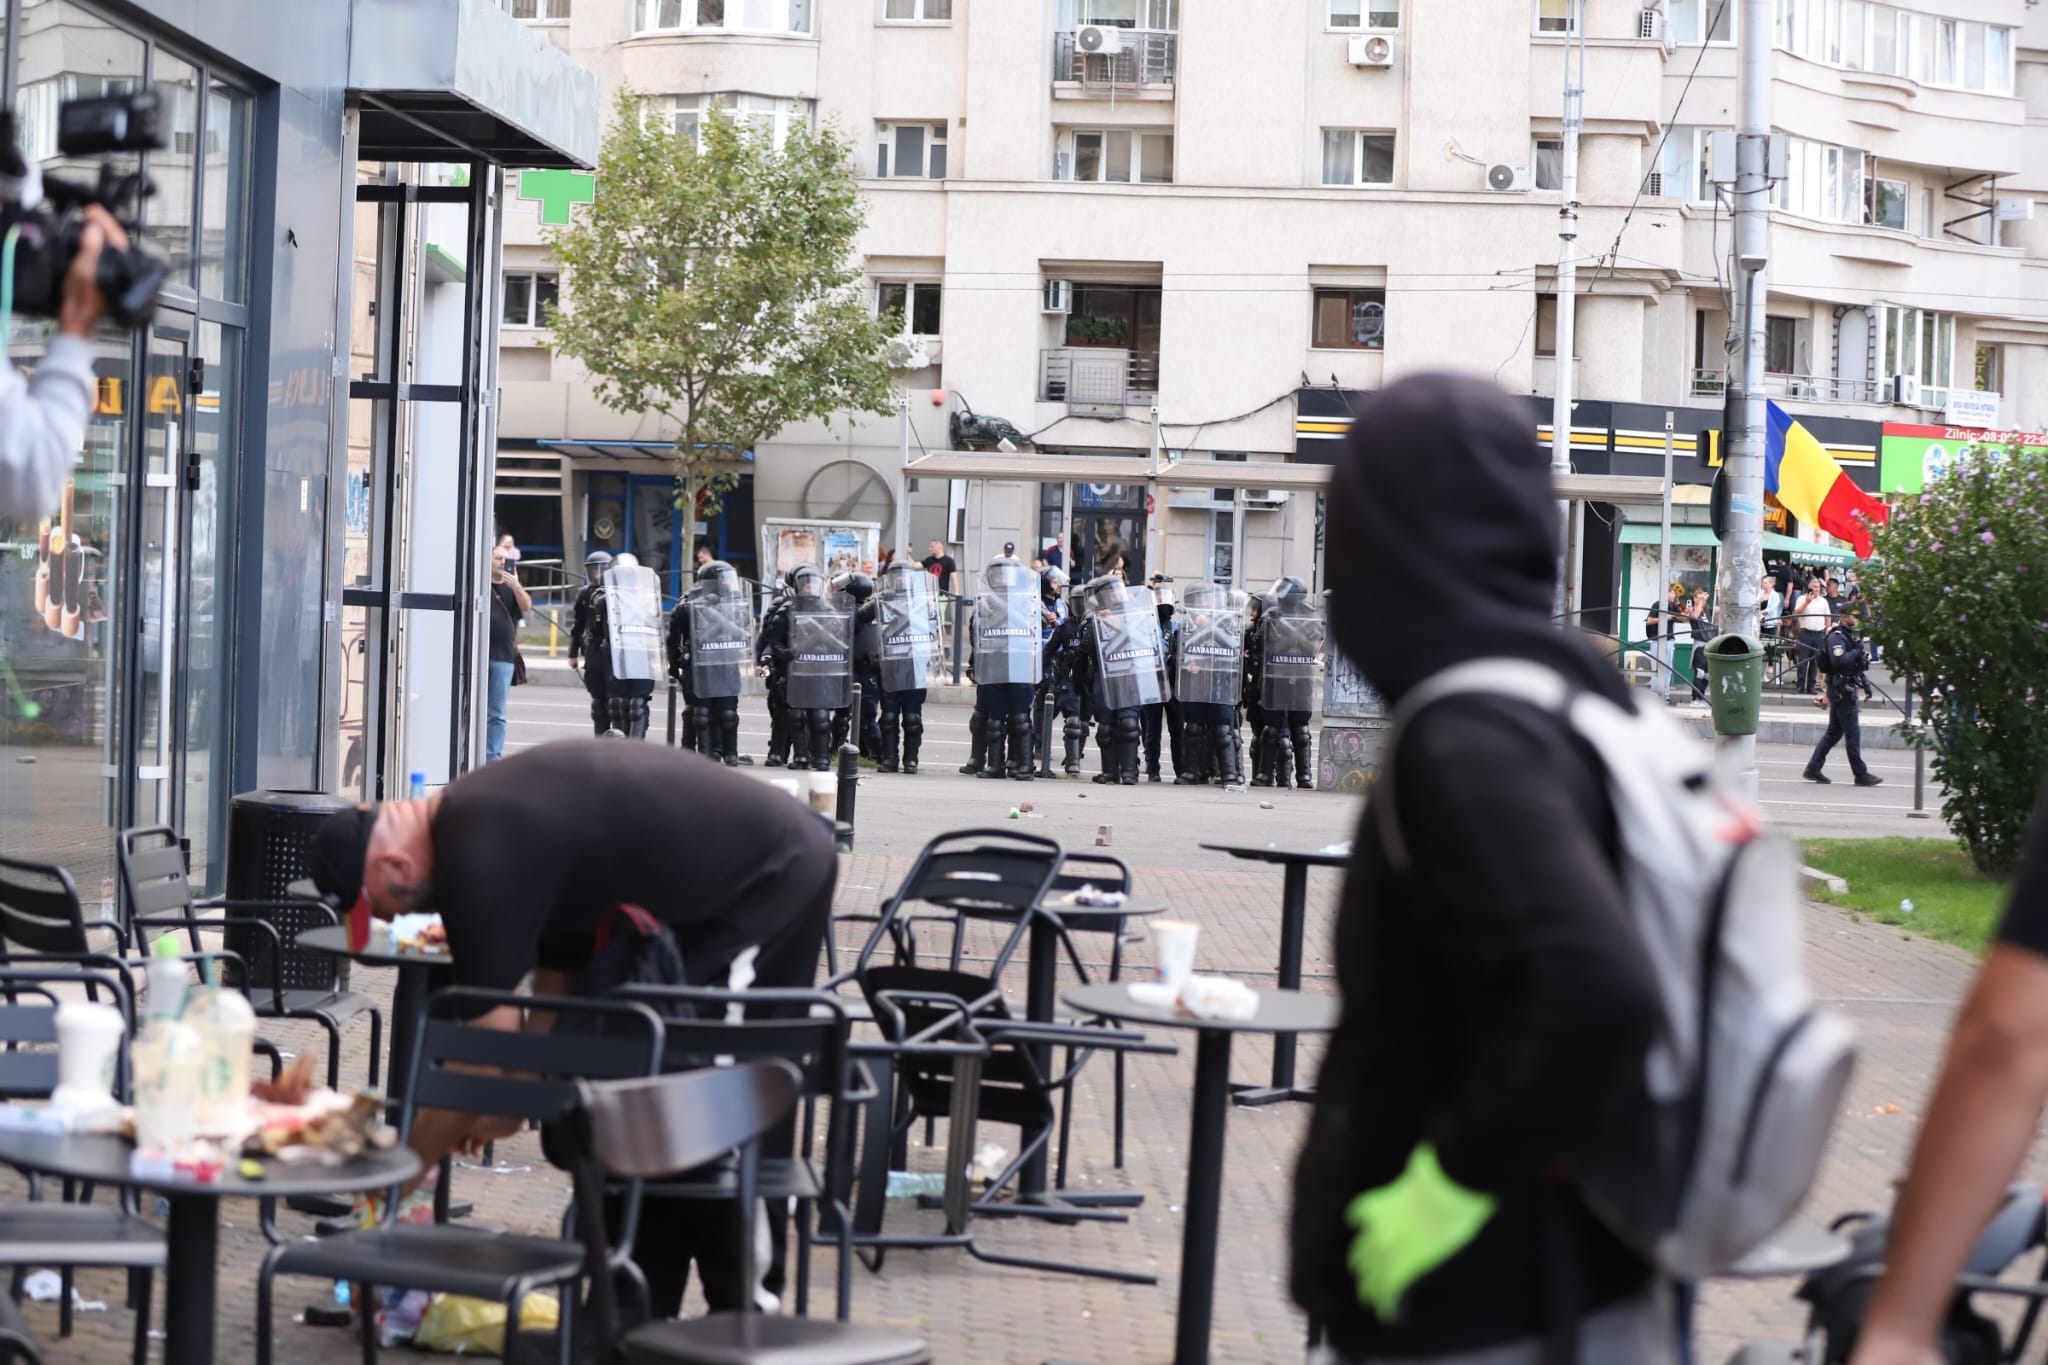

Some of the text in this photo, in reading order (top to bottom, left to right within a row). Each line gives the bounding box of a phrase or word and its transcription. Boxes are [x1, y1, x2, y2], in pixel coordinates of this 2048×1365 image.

[983, 628, 1031, 637] JANDARMERIA
[888, 634, 934, 645] JANDARMERIA
[701, 640, 747, 650] JANDARMERIA
[1109, 647, 1155, 661] JANDARMERIA
[1188, 645, 1234, 656] JANDARMERIA
[799, 653, 844, 662] JANDARMERIA
